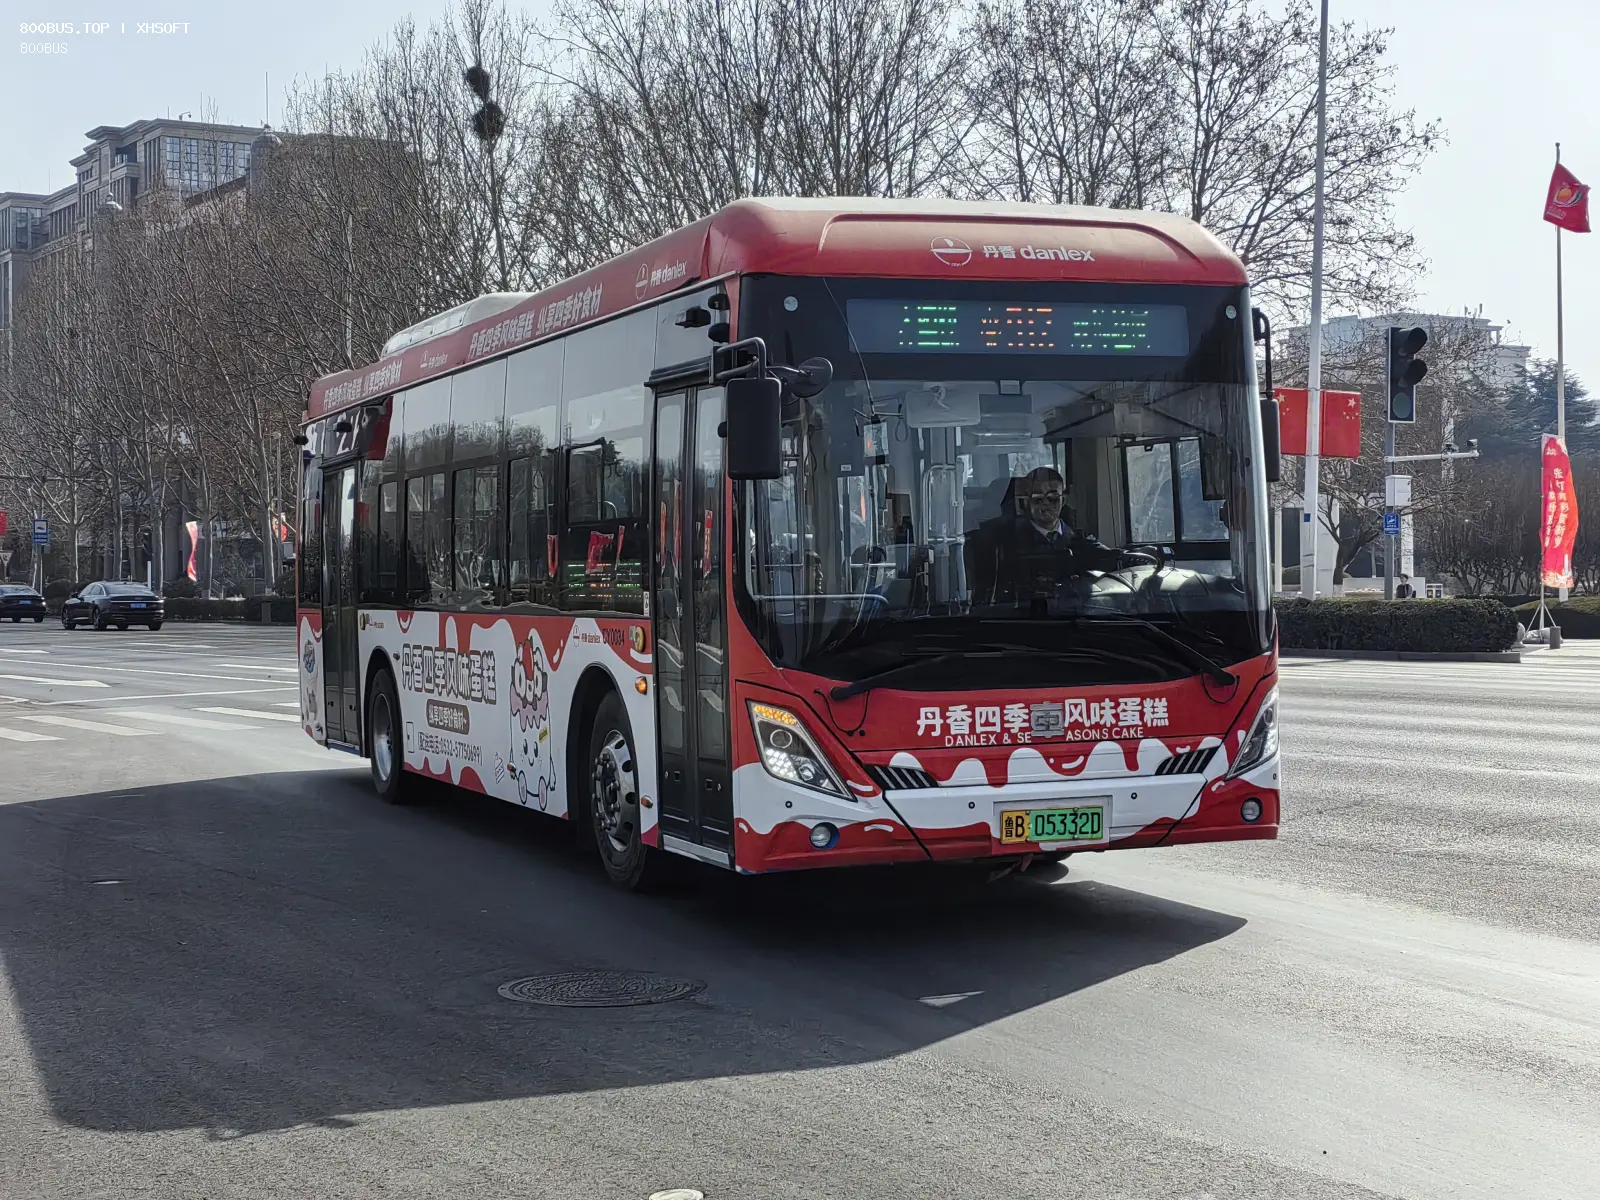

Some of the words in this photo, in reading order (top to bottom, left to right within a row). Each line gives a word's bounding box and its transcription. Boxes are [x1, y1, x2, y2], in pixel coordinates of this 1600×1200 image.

[982, 245, 1016, 259] 丹香
[1020, 245, 1096, 262] danlex
[402, 643, 497, 705] 丹香四季风味蛋糕
[917, 703, 1029, 737] 丹香四季
[1064, 697, 1169, 728] 风味蛋糕
[945, 735, 997, 748] DANLEX
[1002, 734, 1012, 744] &
[1066, 728, 1109, 742] ASONS
[1112, 726, 1144, 739] CAKE
[1035, 812, 1101, 836] 05332D
